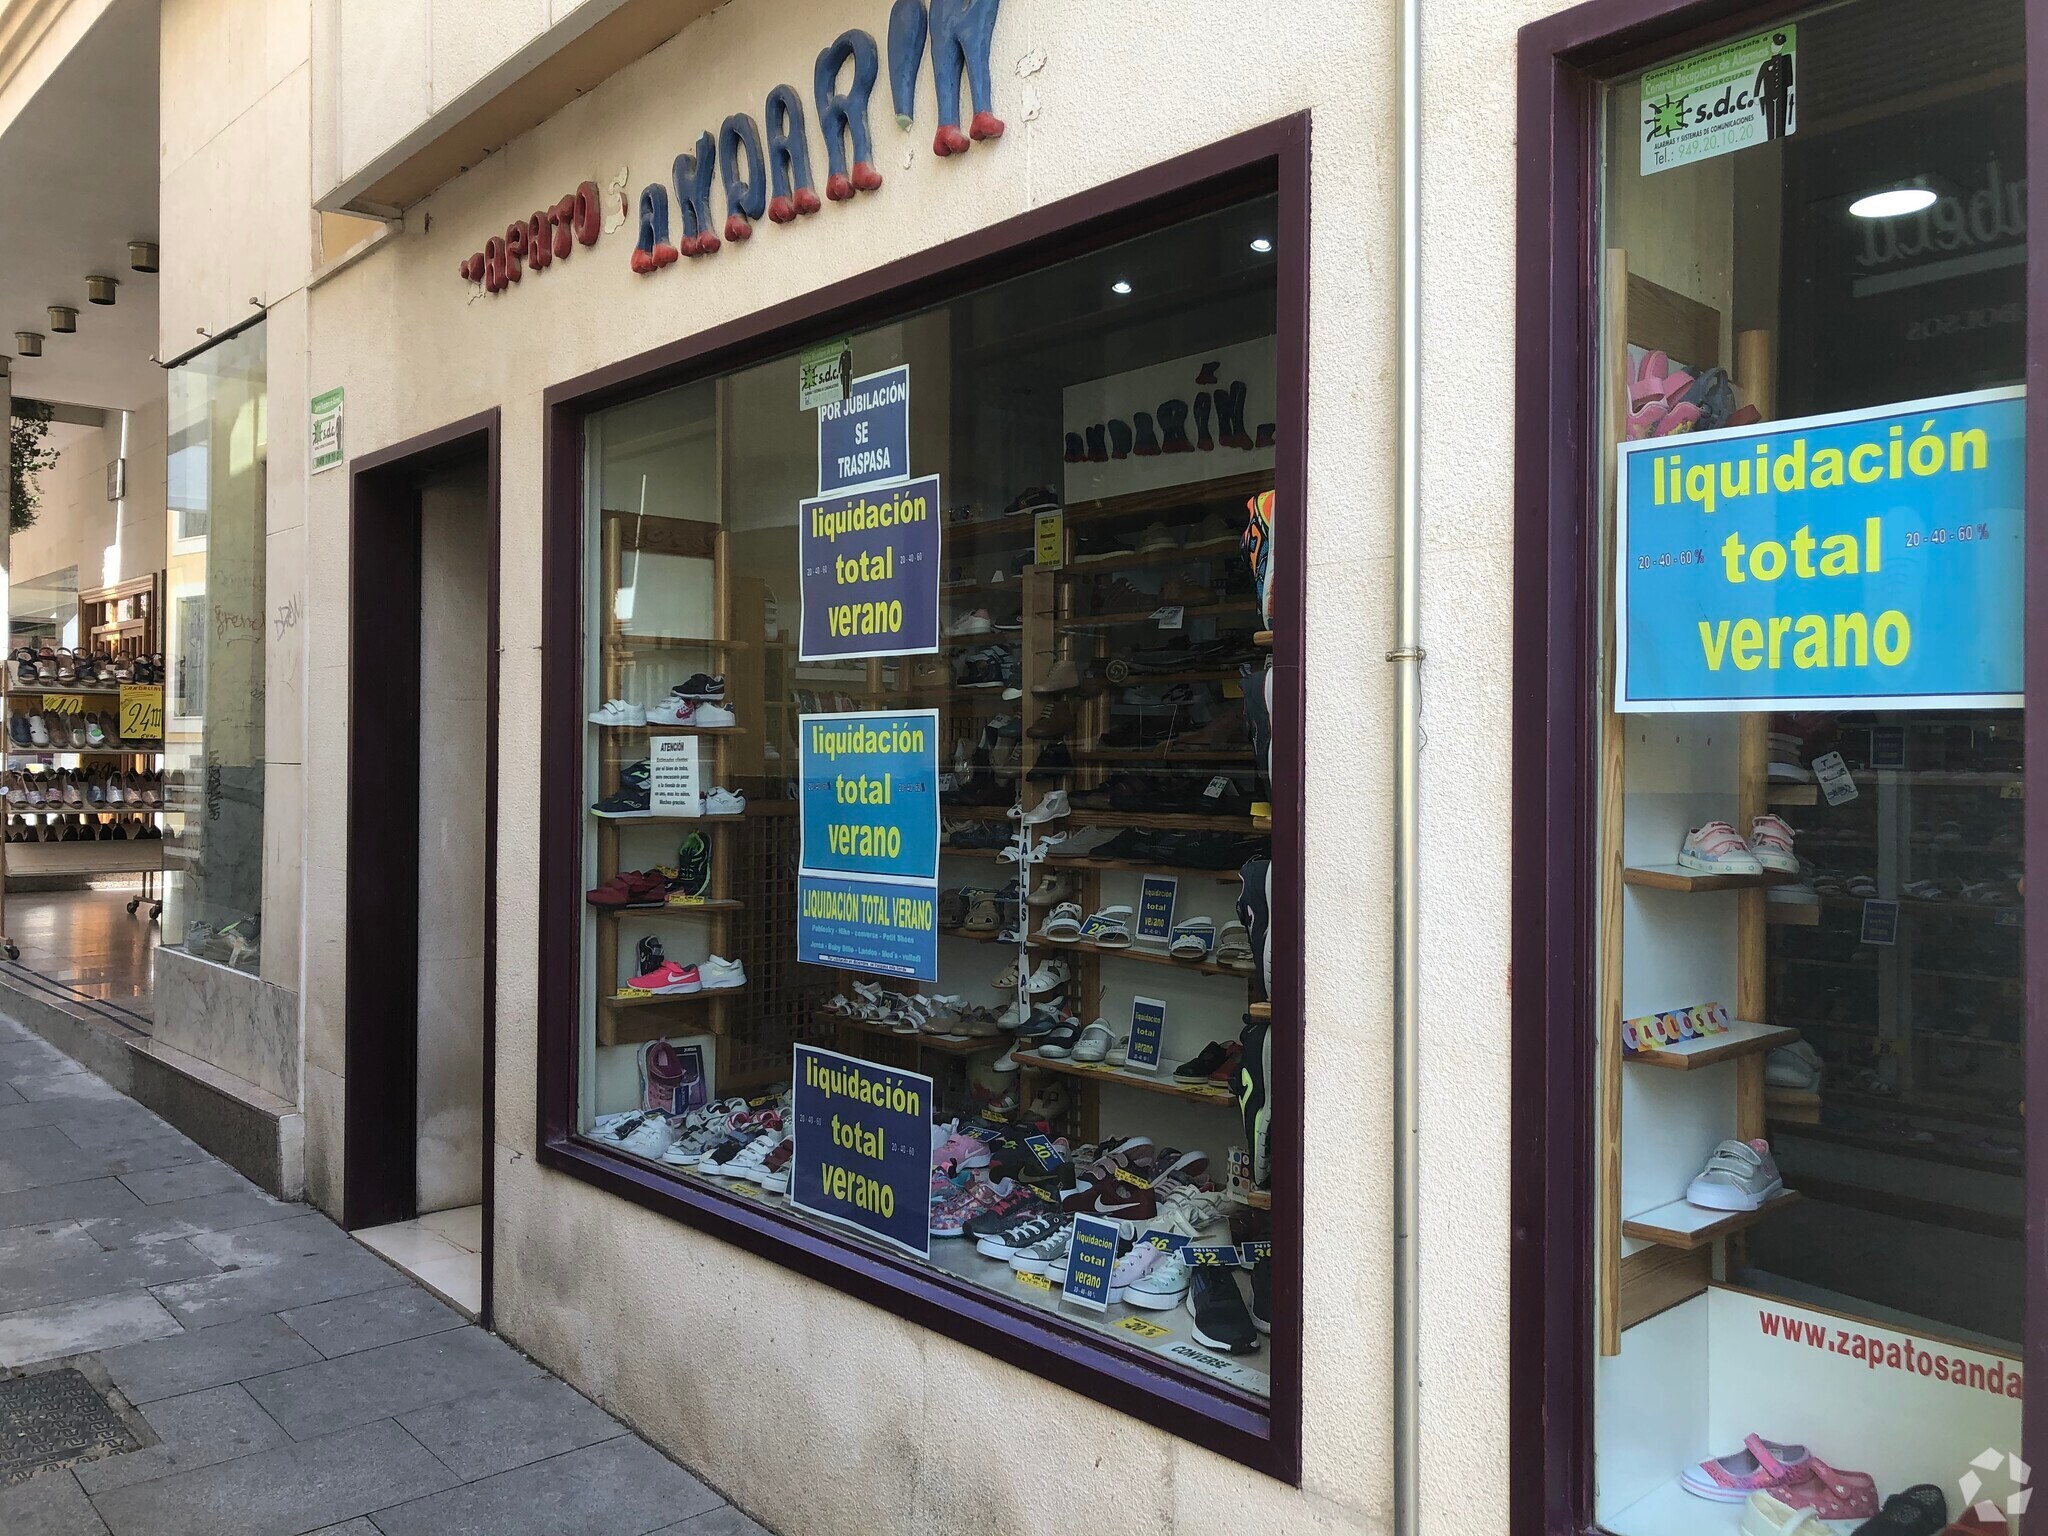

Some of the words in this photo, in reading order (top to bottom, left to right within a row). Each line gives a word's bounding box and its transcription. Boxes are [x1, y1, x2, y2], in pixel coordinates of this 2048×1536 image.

[1645, 65, 1685, 82] Conectado
[1687, 38, 1760, 68] permanentemente
[1694, 85, 1754, 124] s.d.c.
[1654, 140, 1676, 151] ALARMAS
[1680, 130, 1703, 143] SISTEMAS
[1703, 127, 1710, 136] DE
[1710, 113, 1755, 134] COMUNICACIONES
[821, 400, 842, 423] POR
[843, 380, 906, 417] JUBILACIÓN
[855, 421, 869, 446] SE
[837, 446, 891, 479] TRASPASA
[1652, 419, 1989, 514] liquidación
[811, 490, 927, 543] liquidación
[835, 546, 893, 586] total
[1721, 516, 1882, 584] total
[828, 599, 903, 638] verano
[1698, 609, 1911, 671] verano
[660, 740, 685, 752] ATENCIÓN
[811, 721, 924, 762] liquidación
[835, 772, 891, 805] total
[828, 824, 901, 859] verano
[802, 885, 860, 924] LIQUIDACIÓN
[861, 894, 891, 928] TOTAL
[892, 897, 933, 932] VERANO
[1144, 916, 1166, 929] verano
[1146, 902, 1167, 912] total
[1136, 1026, 1155, 1037] total
[1628, 1007, 1729, 1043] PABLOSKY
[1134, 1042, 1154, 1055] verano
[806, 1055, 920, 1118] liquidación
[831, 1113, 885, 1162] total
[821, 1162, 895, 1220] verano
[1076, 1230, 1113, 1250] liquidación
[1193, 1252, 1221, 1265] 32
[1079, 1251, 1106, 1268] total
[1075, 1269, 1101, 1289] verano
[1171, 1345, 1232, 1370] CONVERSE
[1758, 1310, 2024, 1400] www.zapatosanda
